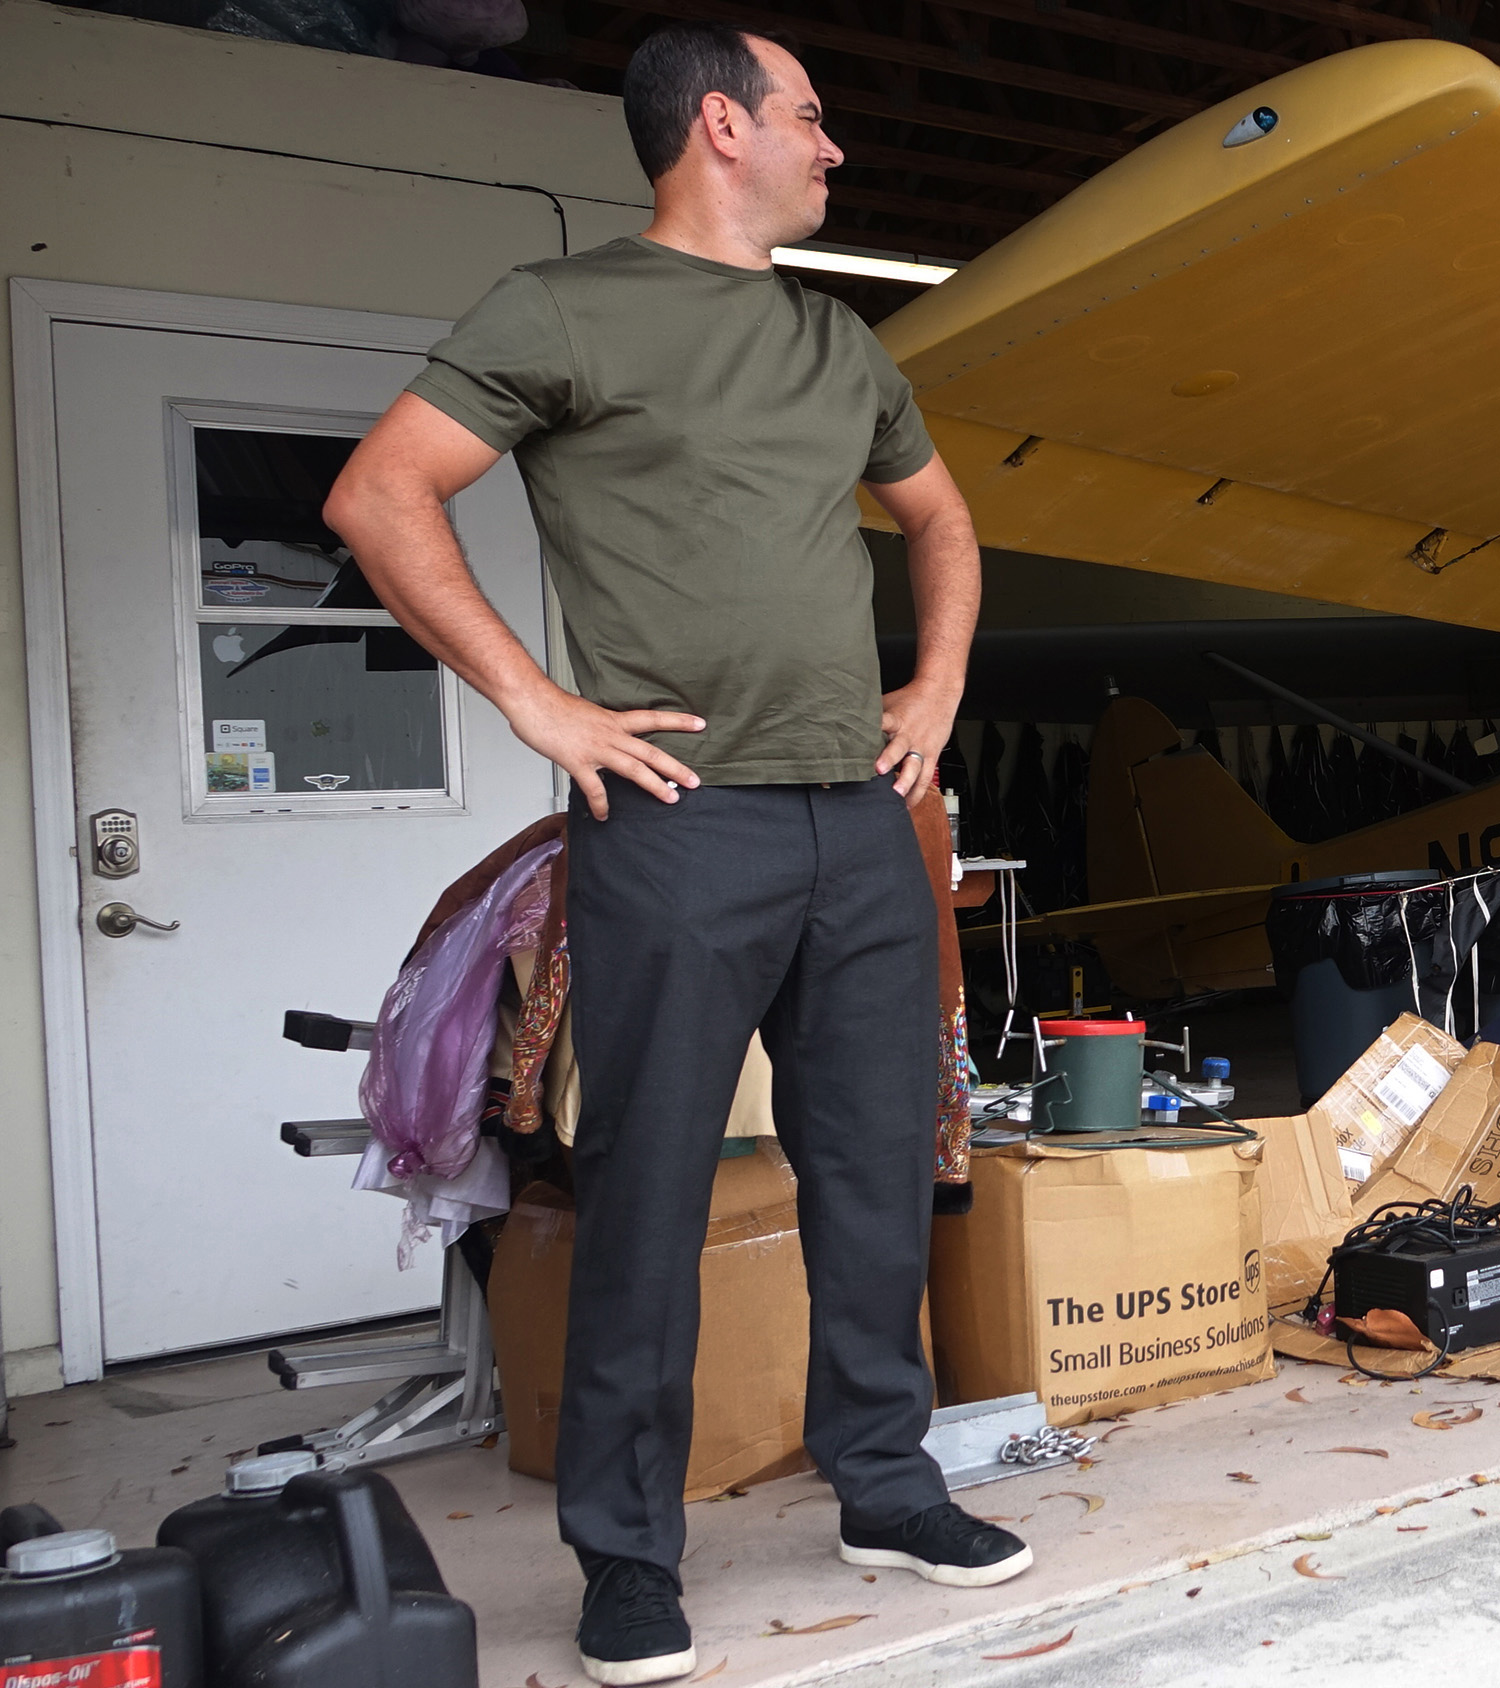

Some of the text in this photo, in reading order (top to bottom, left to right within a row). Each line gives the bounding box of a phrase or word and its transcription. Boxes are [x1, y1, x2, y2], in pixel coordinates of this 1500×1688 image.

[213, 562, 255, 570] GoPro
[231, 725, 259, 733] Square
[1245, 1261, 1260, 1288] ups
[1047, 1282, 1240, 1326] The UPS Store
[1050, 1315, 1265, 1373] Small Business Solutions
[1050, 1382, 1147, 1407] theupsstore.com
